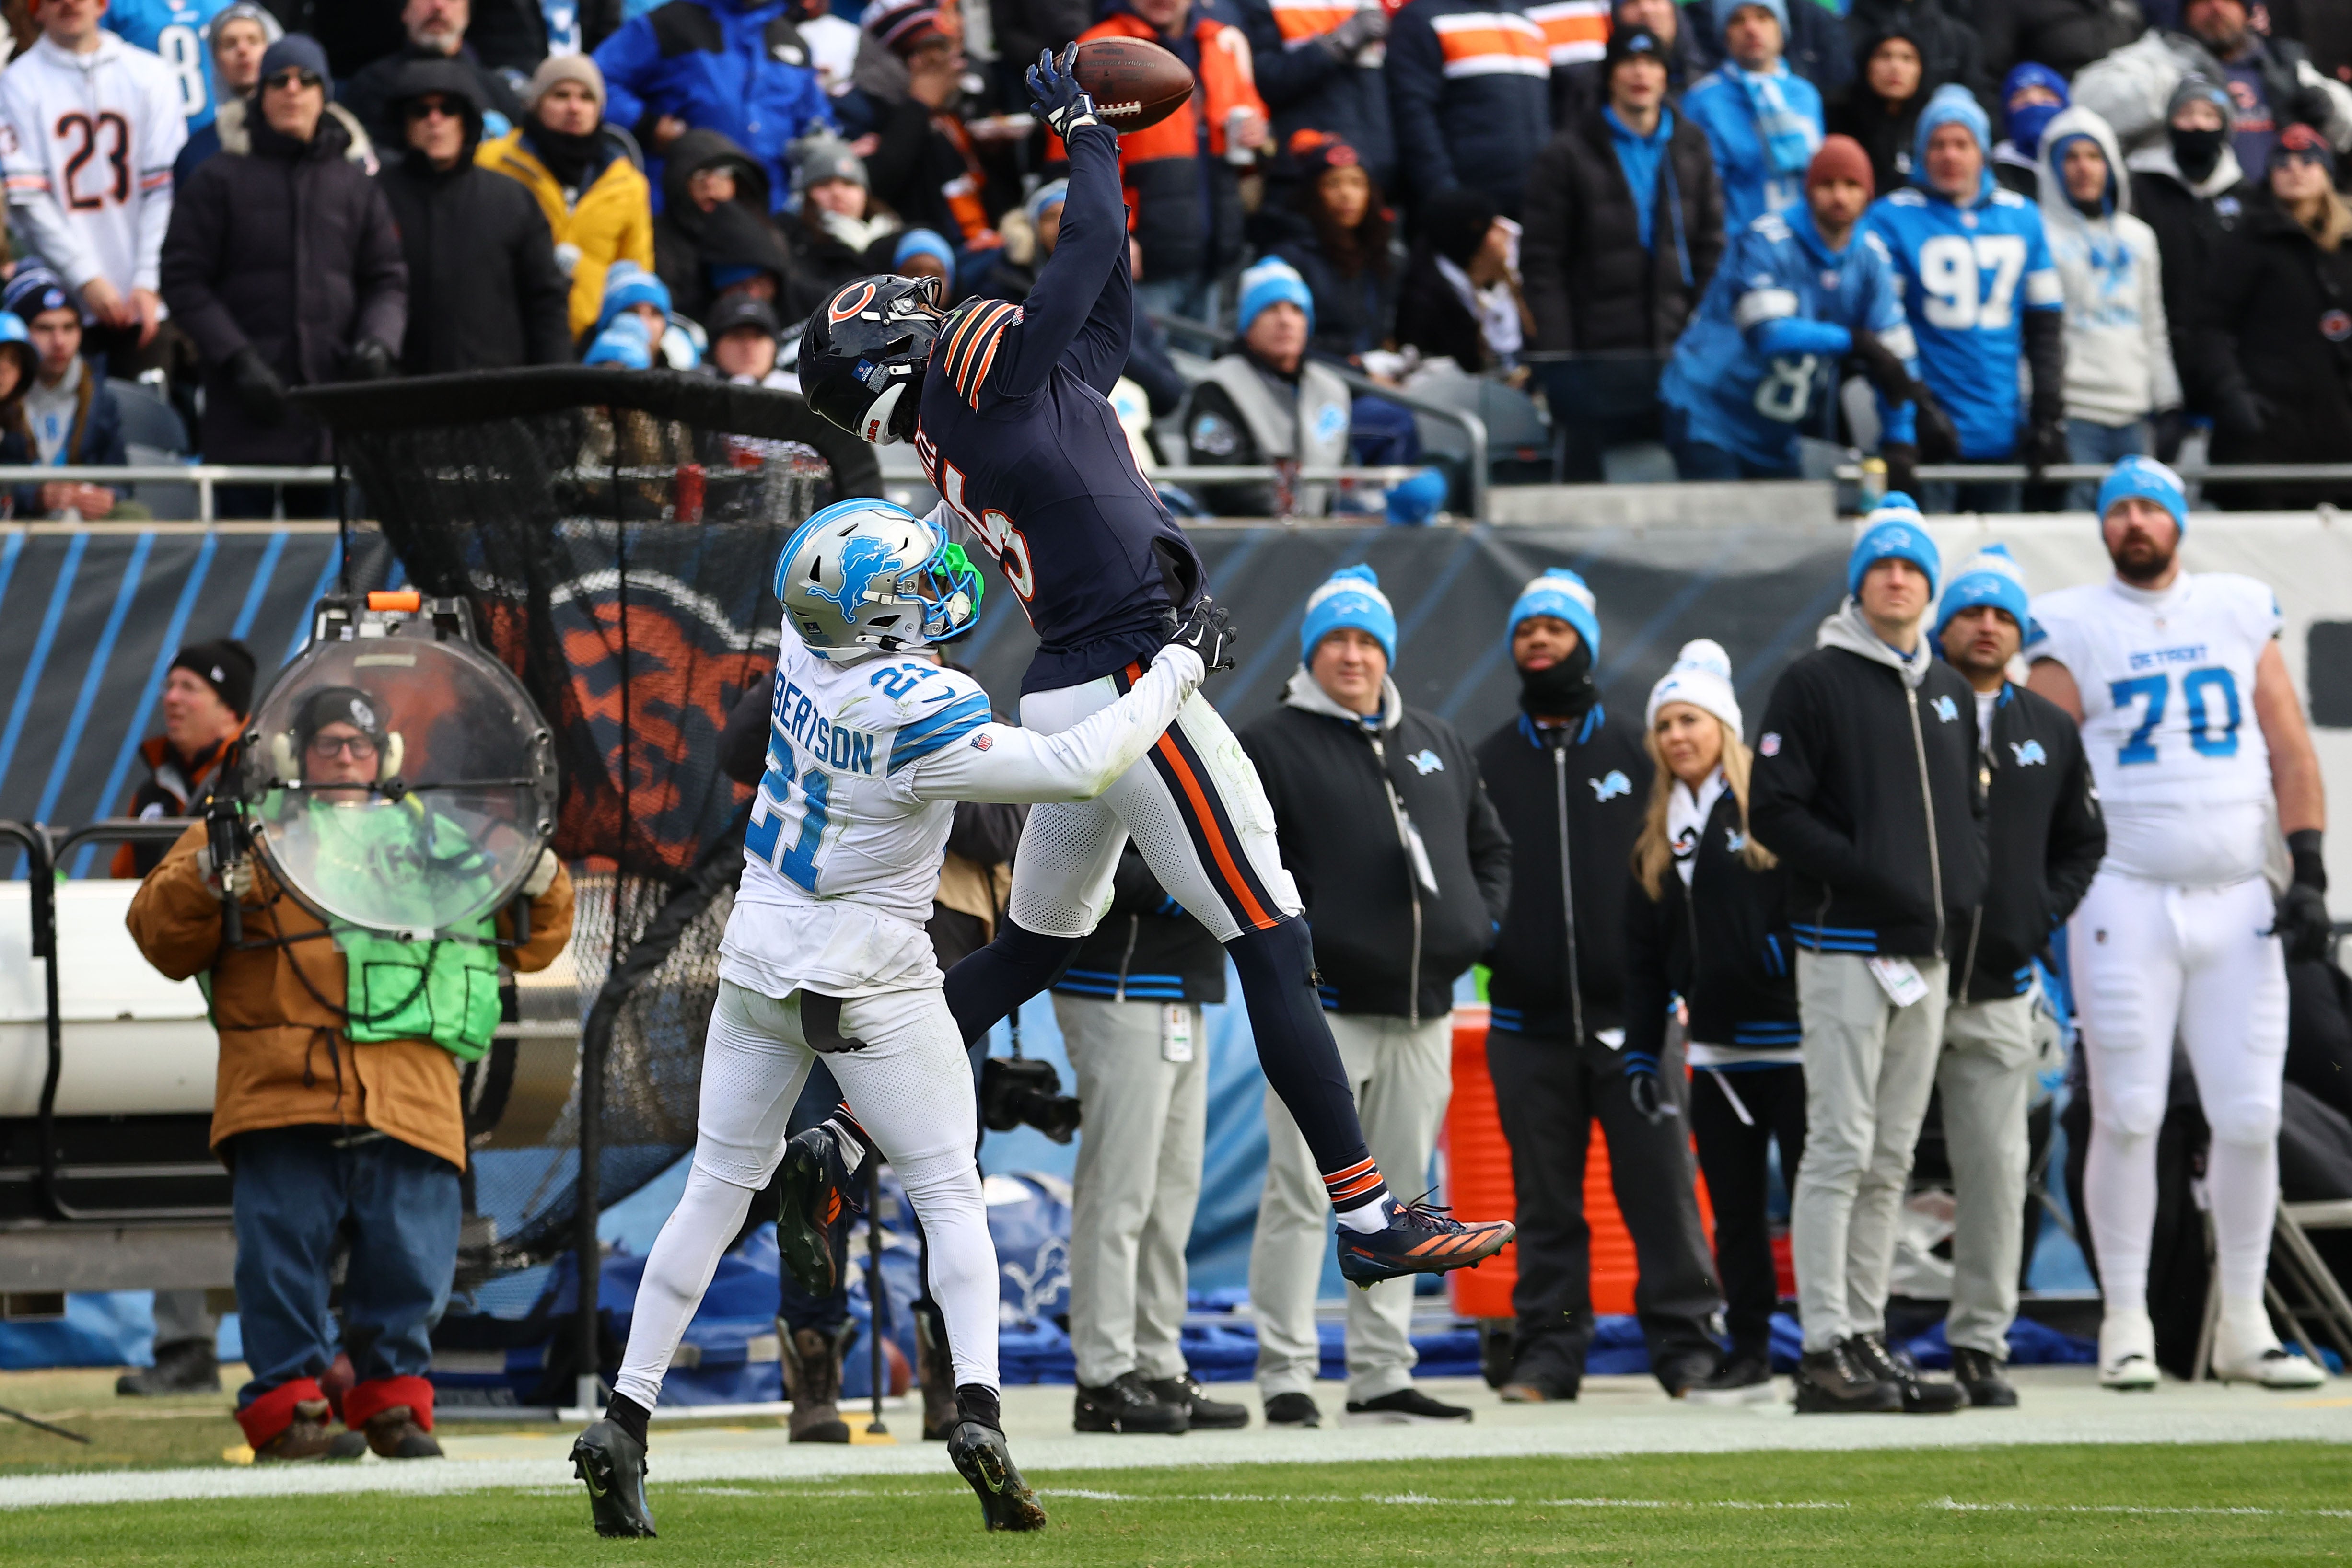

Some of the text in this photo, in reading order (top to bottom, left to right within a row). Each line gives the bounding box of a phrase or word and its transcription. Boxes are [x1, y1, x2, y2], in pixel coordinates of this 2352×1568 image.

[158, 24, 211, 118] 8
[56, 111, 129, 211] 23
[1919, 234, 2027, 331] 97
[867, 419, 880, 443] ARS
[1754, 353, 1823, 423] 8
[942, 457, 1036, 603] 5
[773, 670, 873, 775] BERTSON
[869, 663, 941, 702] 21
[2109, 667, 2242, 766] 70
[744, 722, 833, 895] 21
